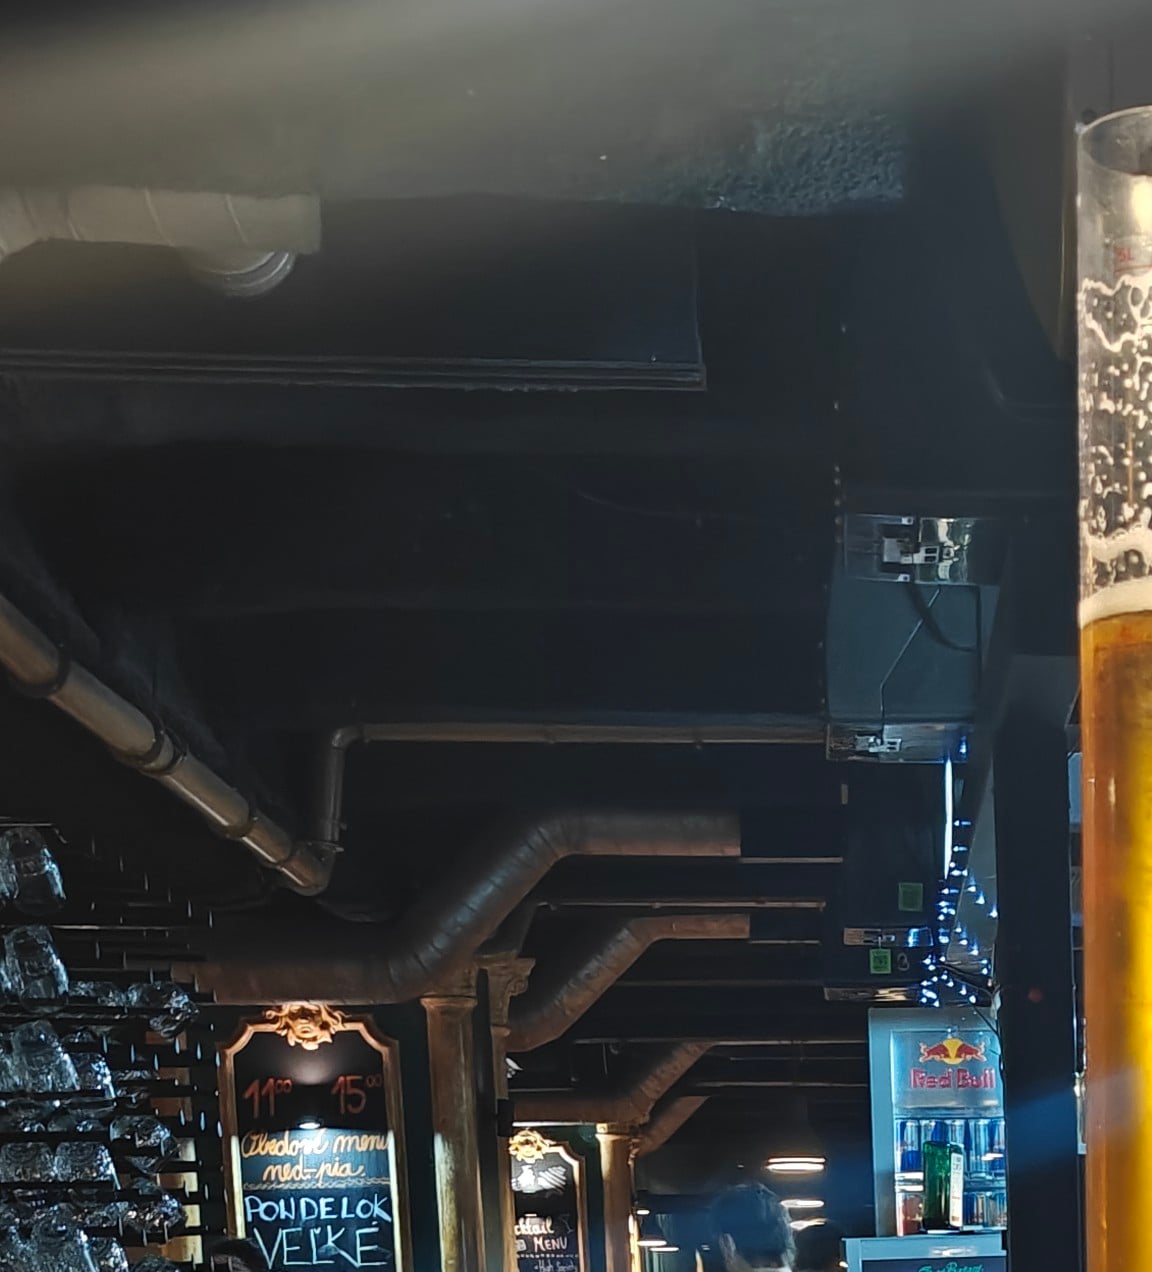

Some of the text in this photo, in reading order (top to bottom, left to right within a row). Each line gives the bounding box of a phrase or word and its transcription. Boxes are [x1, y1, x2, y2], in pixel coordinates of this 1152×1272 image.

[911, 1067, 996, 1089] Red Bull
[244, 1193, 393, 1223] PONDELOK
[533, 1236, 568, 1253] MENU
